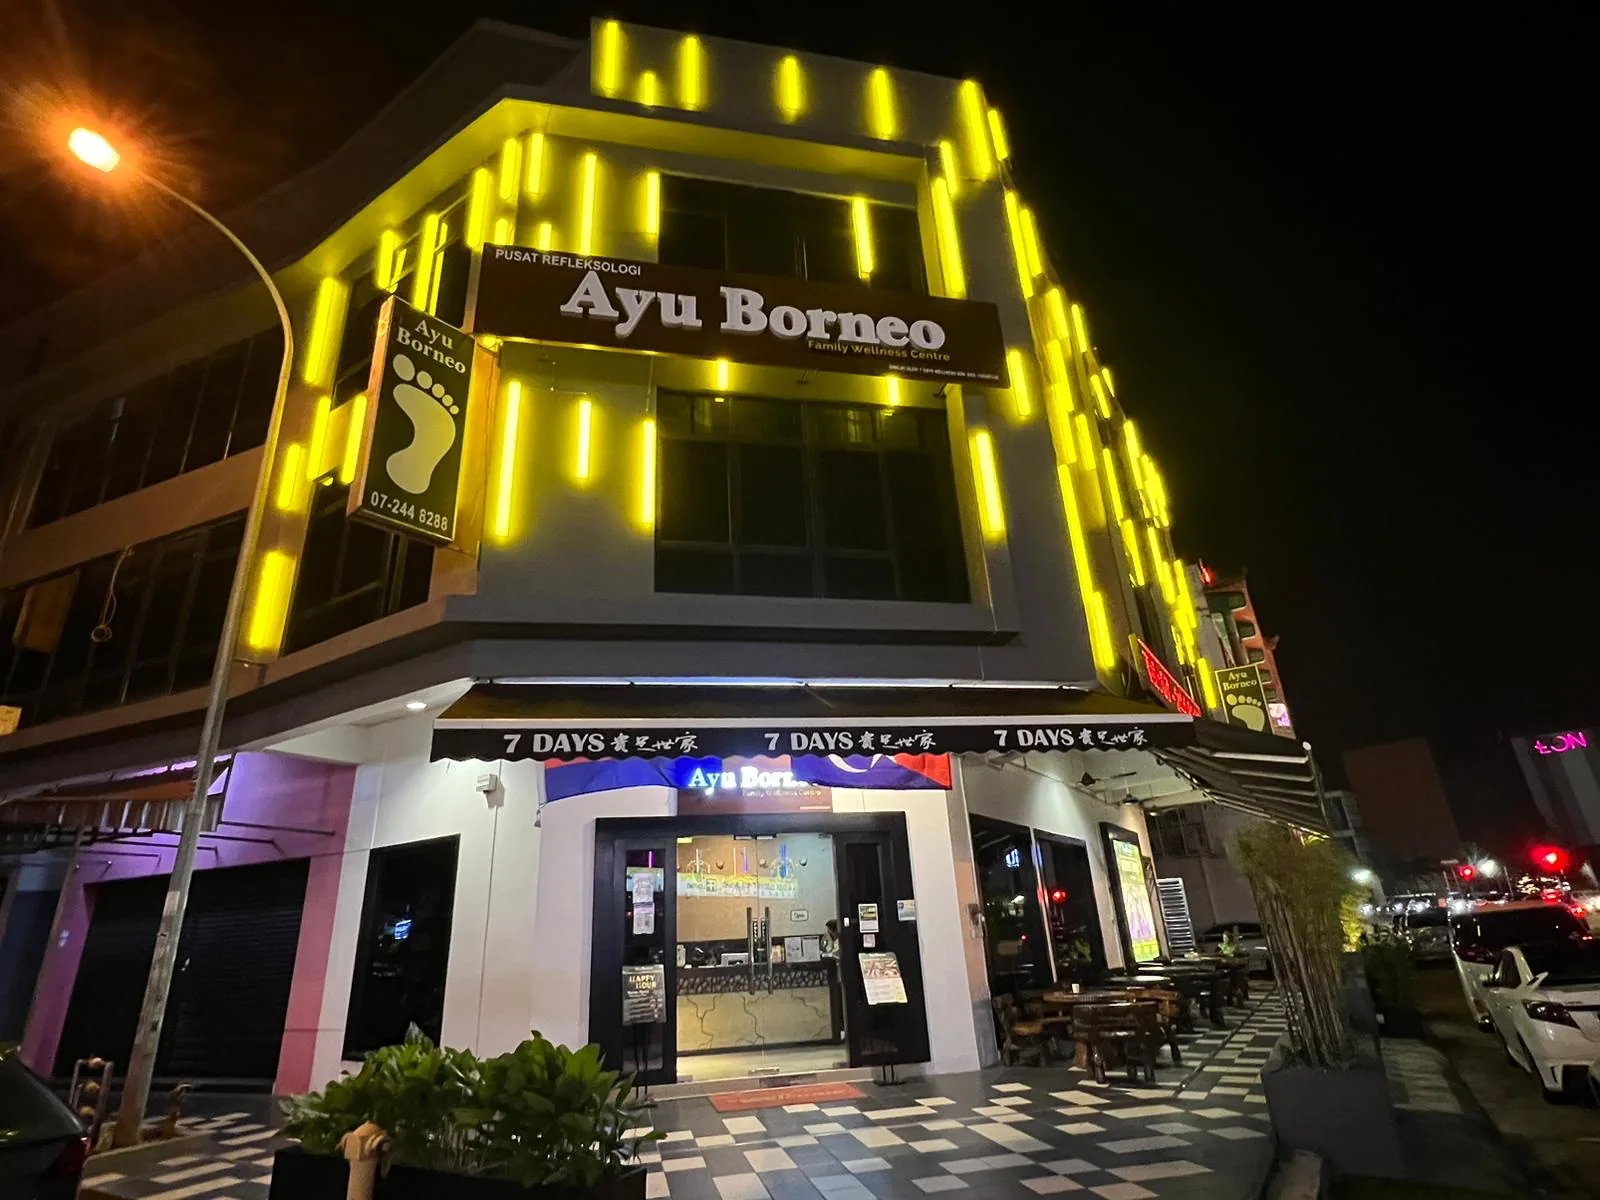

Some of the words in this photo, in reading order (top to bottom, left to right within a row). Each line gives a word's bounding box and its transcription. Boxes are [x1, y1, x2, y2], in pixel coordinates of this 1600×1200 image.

[495, 248, 539, 263] PUSAT
[542, 253, 641, 276] REFLEKSOLOGI
[560, 270, 702, 339] Ayu
[720, 286, 946, 350] Borneo
[414, 319, 454, 350] Ayu
[396, 326, 466, 374] Borneo
[807, 340, 849, 354] Family
[851, 344, 908, 358] Wellness
[910, 349, 950, 361] Centre
[370, 491, 415, 519] 07-244
[418, 508, 448, 531] 8288
[1222, 679, 1257, 691] Borneo
[1227, 670, 1248, 681] Ayu
[503, 733, 522, 753] 7
[532, 733, 605, 753] DAYS
[764, 732, 780, 751] 7
[790, 732, 854, 751] DAYS
[993, 729, 1008, 746] 7
[1017, 728, 1074, 746] DAYS
[688, 767, 737, 795] Ayu
